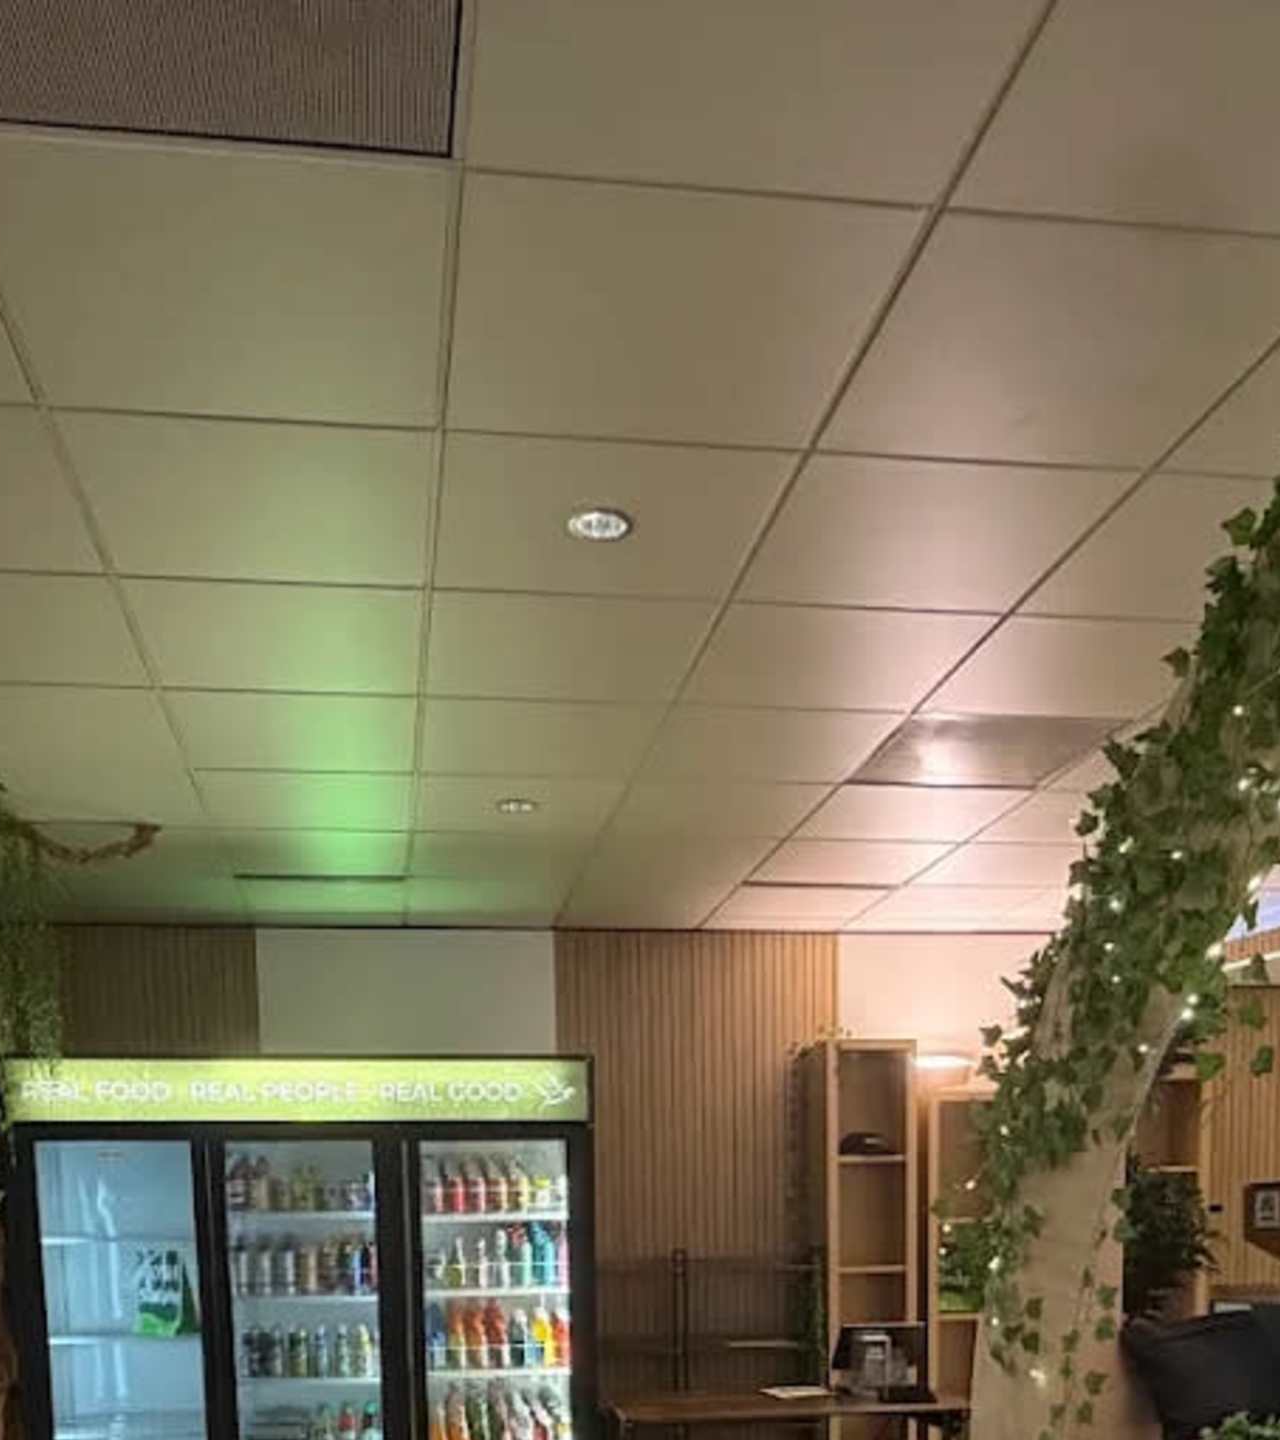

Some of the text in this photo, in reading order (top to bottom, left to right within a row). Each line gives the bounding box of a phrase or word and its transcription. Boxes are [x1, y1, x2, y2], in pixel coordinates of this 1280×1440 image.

[94, 1081, 172, 1101] FOOD
[190, 1081, 256, 1101] REAL
[262, 1080, 360, 1102] PEOPLE
[379, 1080, 442, 1102] REAL
[447, 1081, 523, 1102] GOOD
